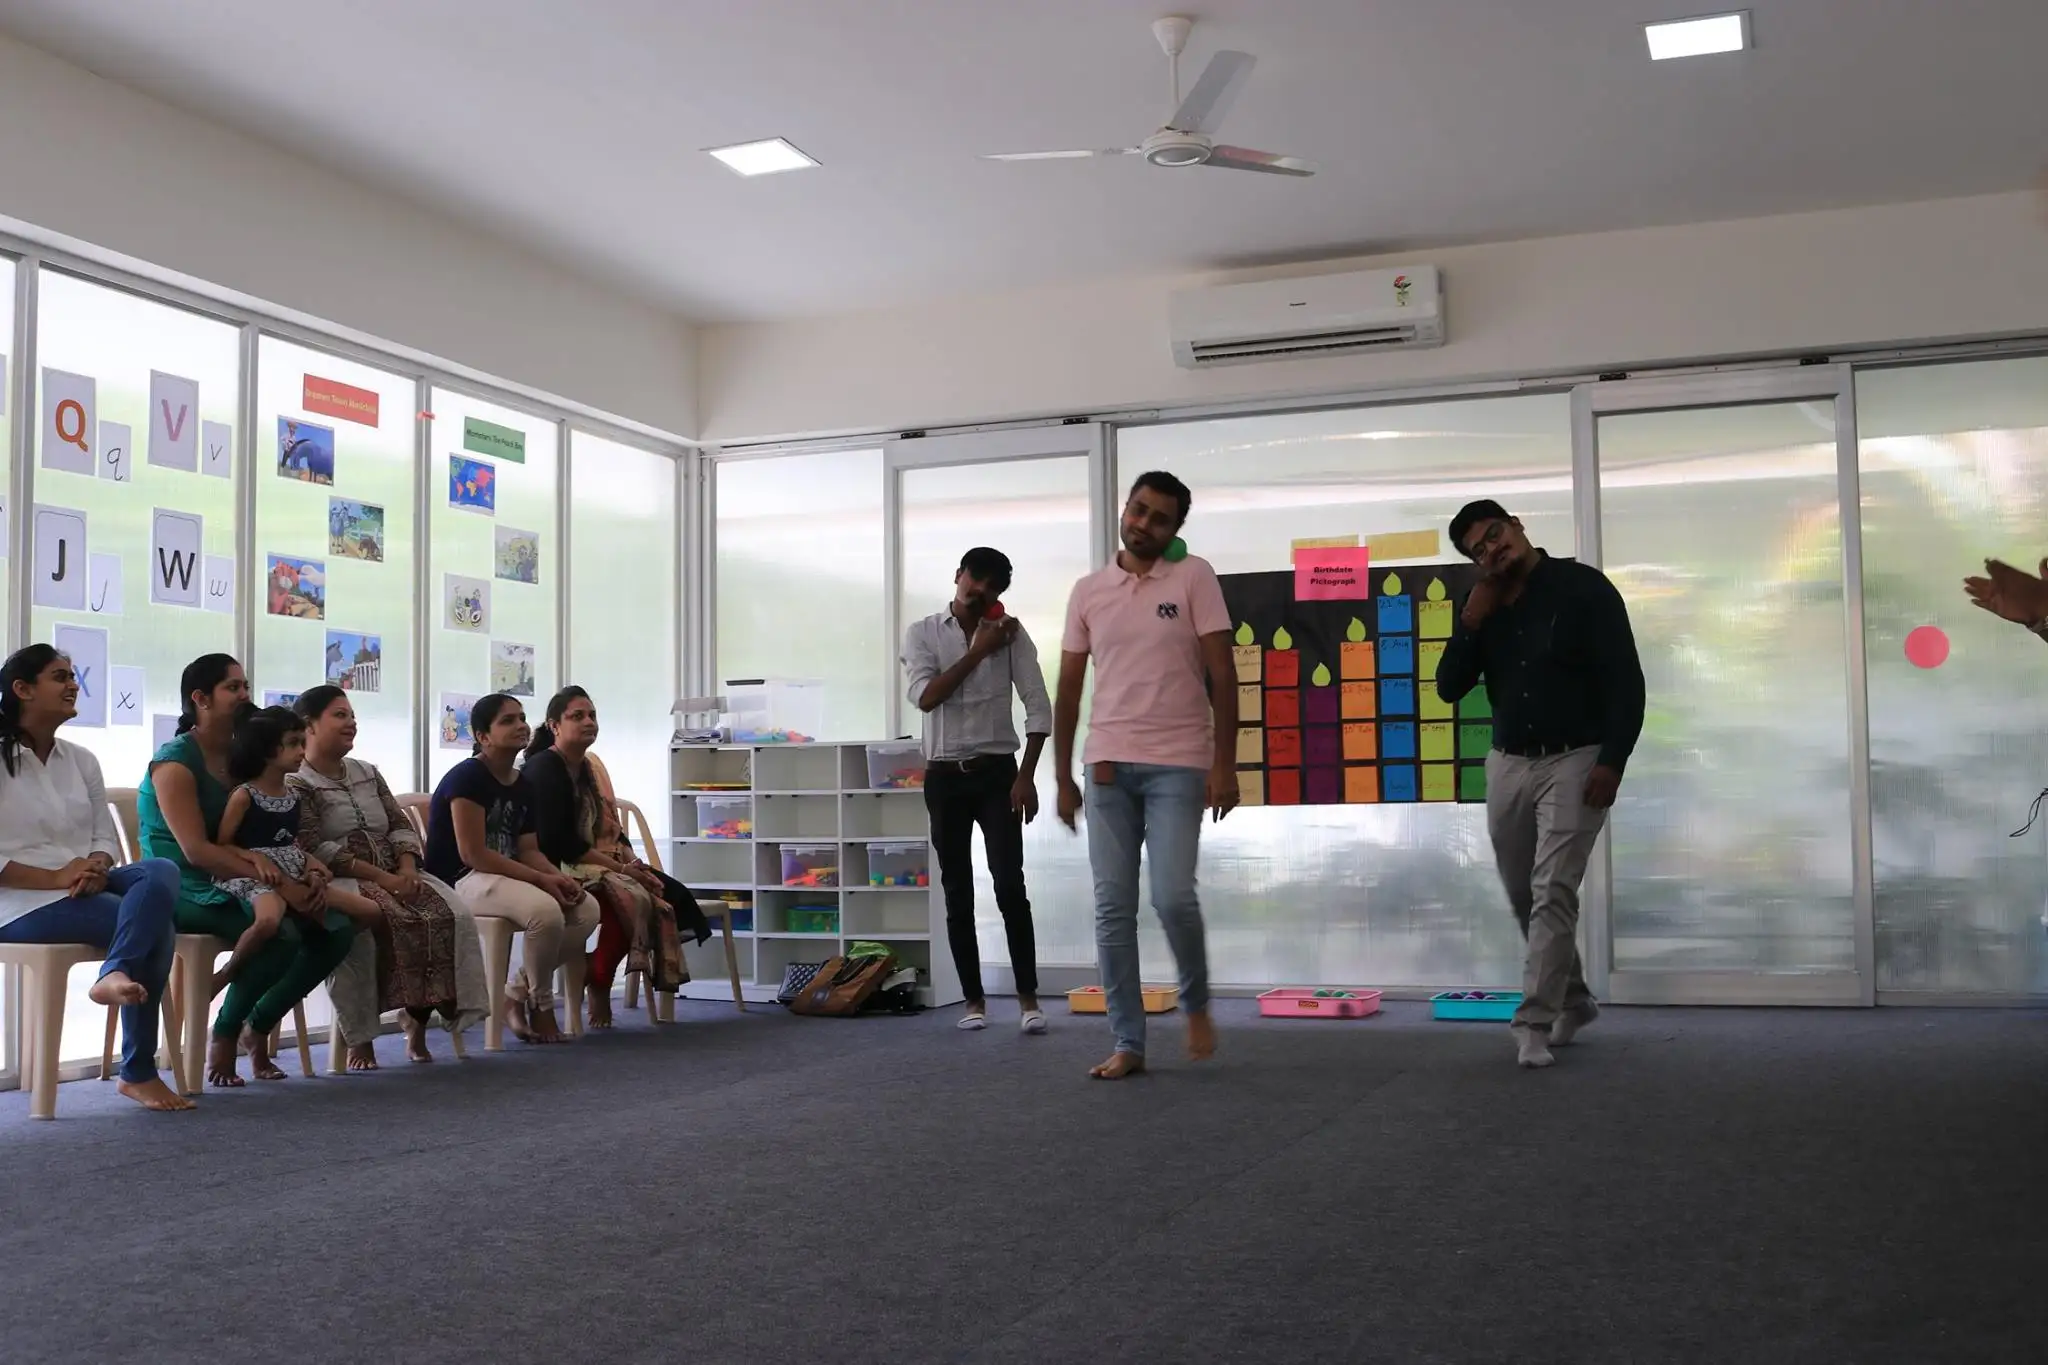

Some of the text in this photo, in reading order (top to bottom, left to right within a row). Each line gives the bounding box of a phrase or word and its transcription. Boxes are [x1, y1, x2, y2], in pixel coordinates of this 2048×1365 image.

[55, 399, 88, 453] Q
[161, 398, 187, 442] V
[106, 447, 123, 481] q
[51, 538, 66, 582] J
[158, 547, 196, 591] W
[1310, 578, 1356, 586] Pictograph
